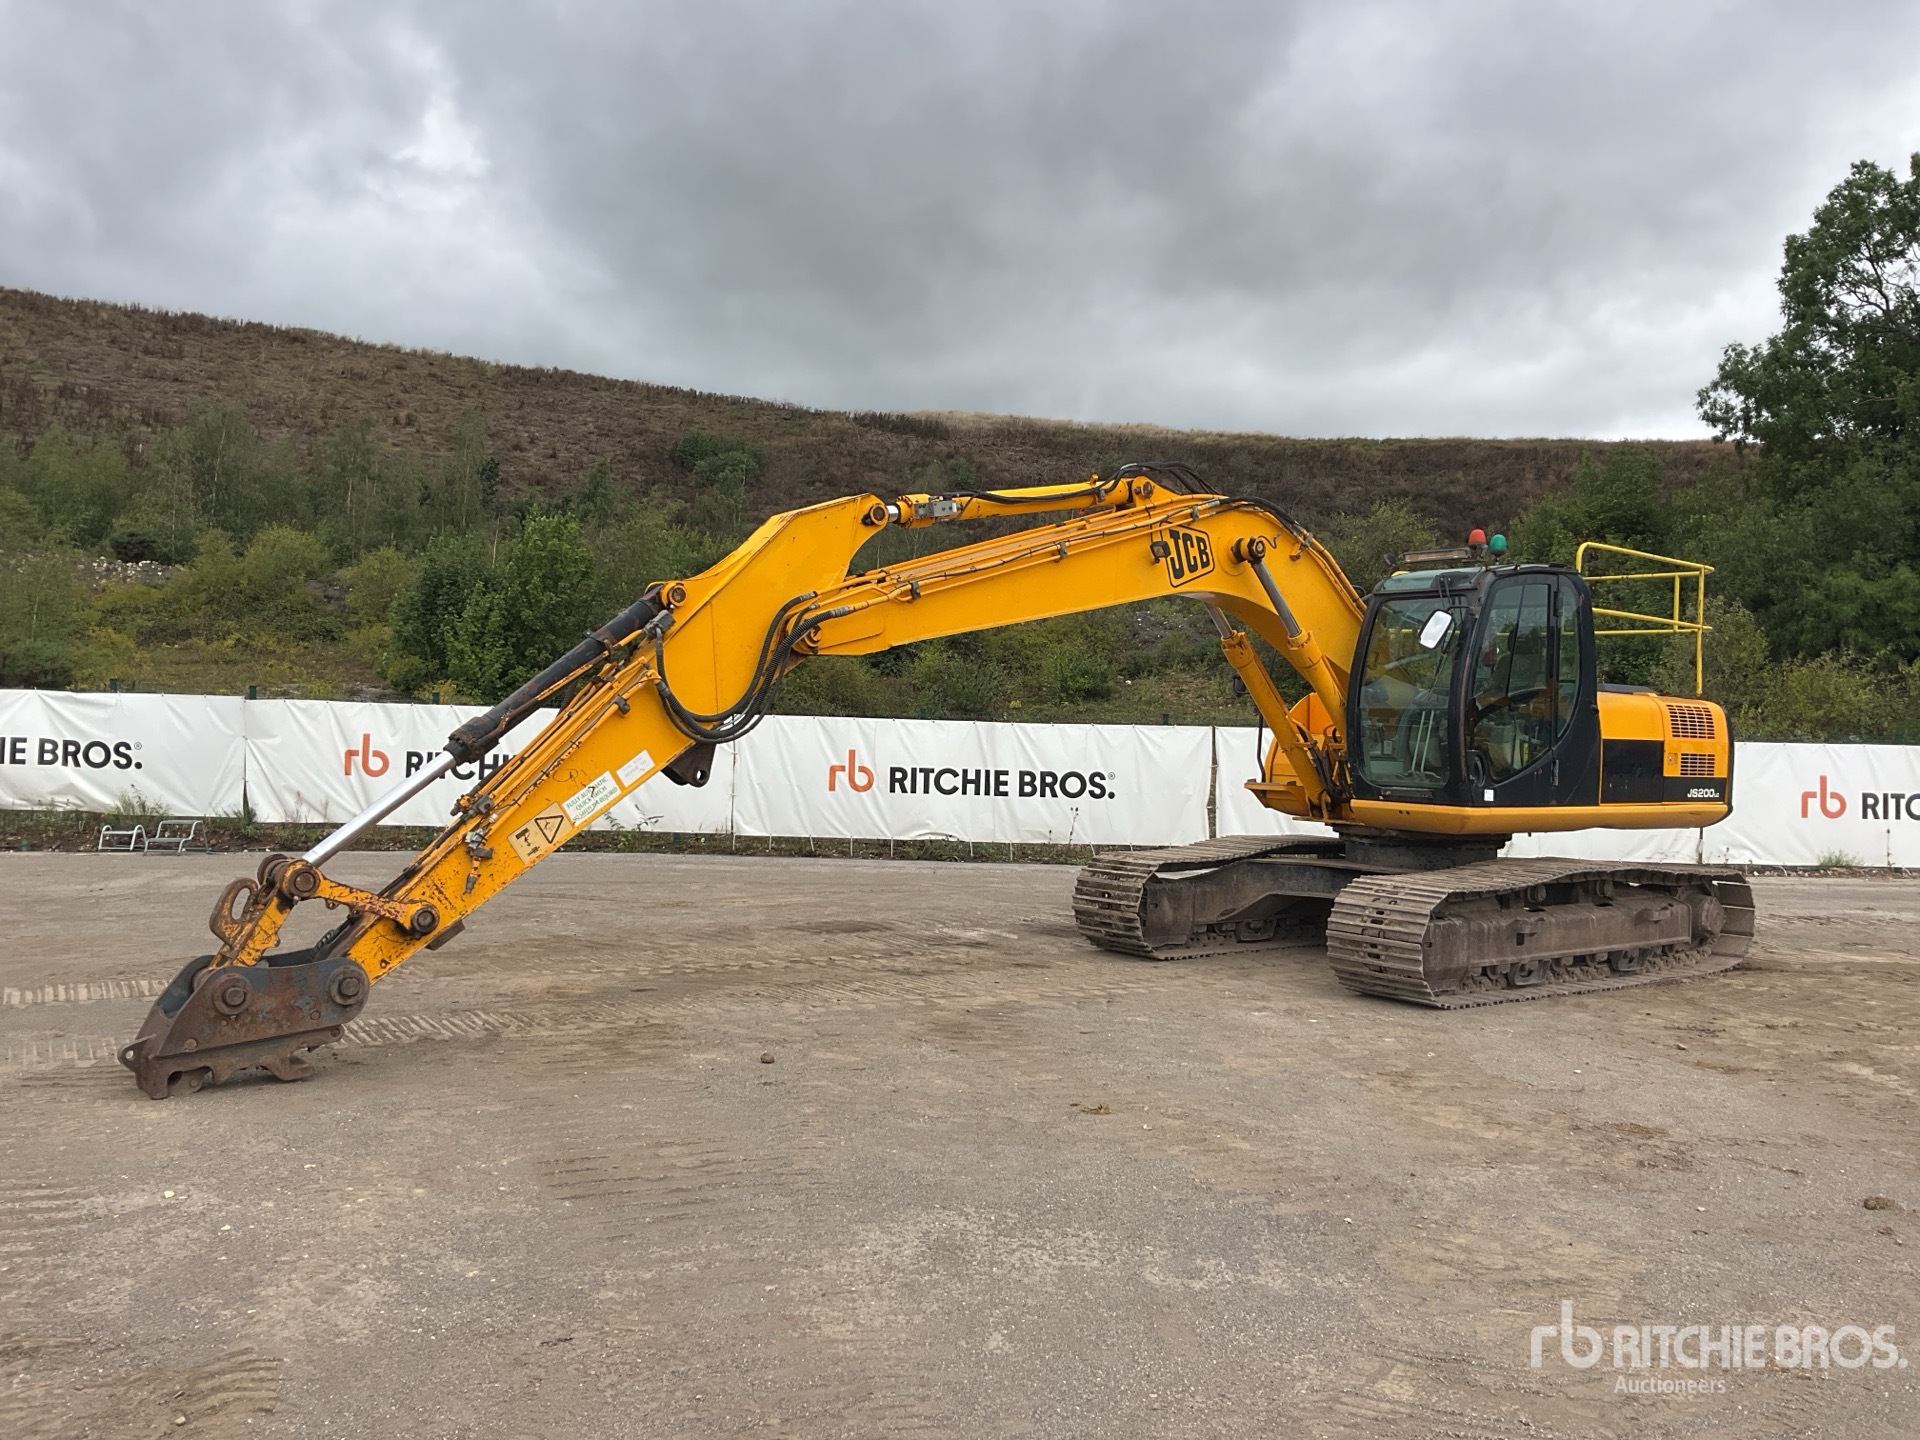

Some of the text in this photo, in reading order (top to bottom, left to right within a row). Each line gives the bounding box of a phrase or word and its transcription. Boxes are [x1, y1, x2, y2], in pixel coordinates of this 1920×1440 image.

[1169, 529, 1211, 580] JCB
[344, 733, 390, 778] rb
[828, 749, 875, 793] rb
[889, 766, 1009, 797] RITCHIE
[1801, 775, 1847, 819] rb
